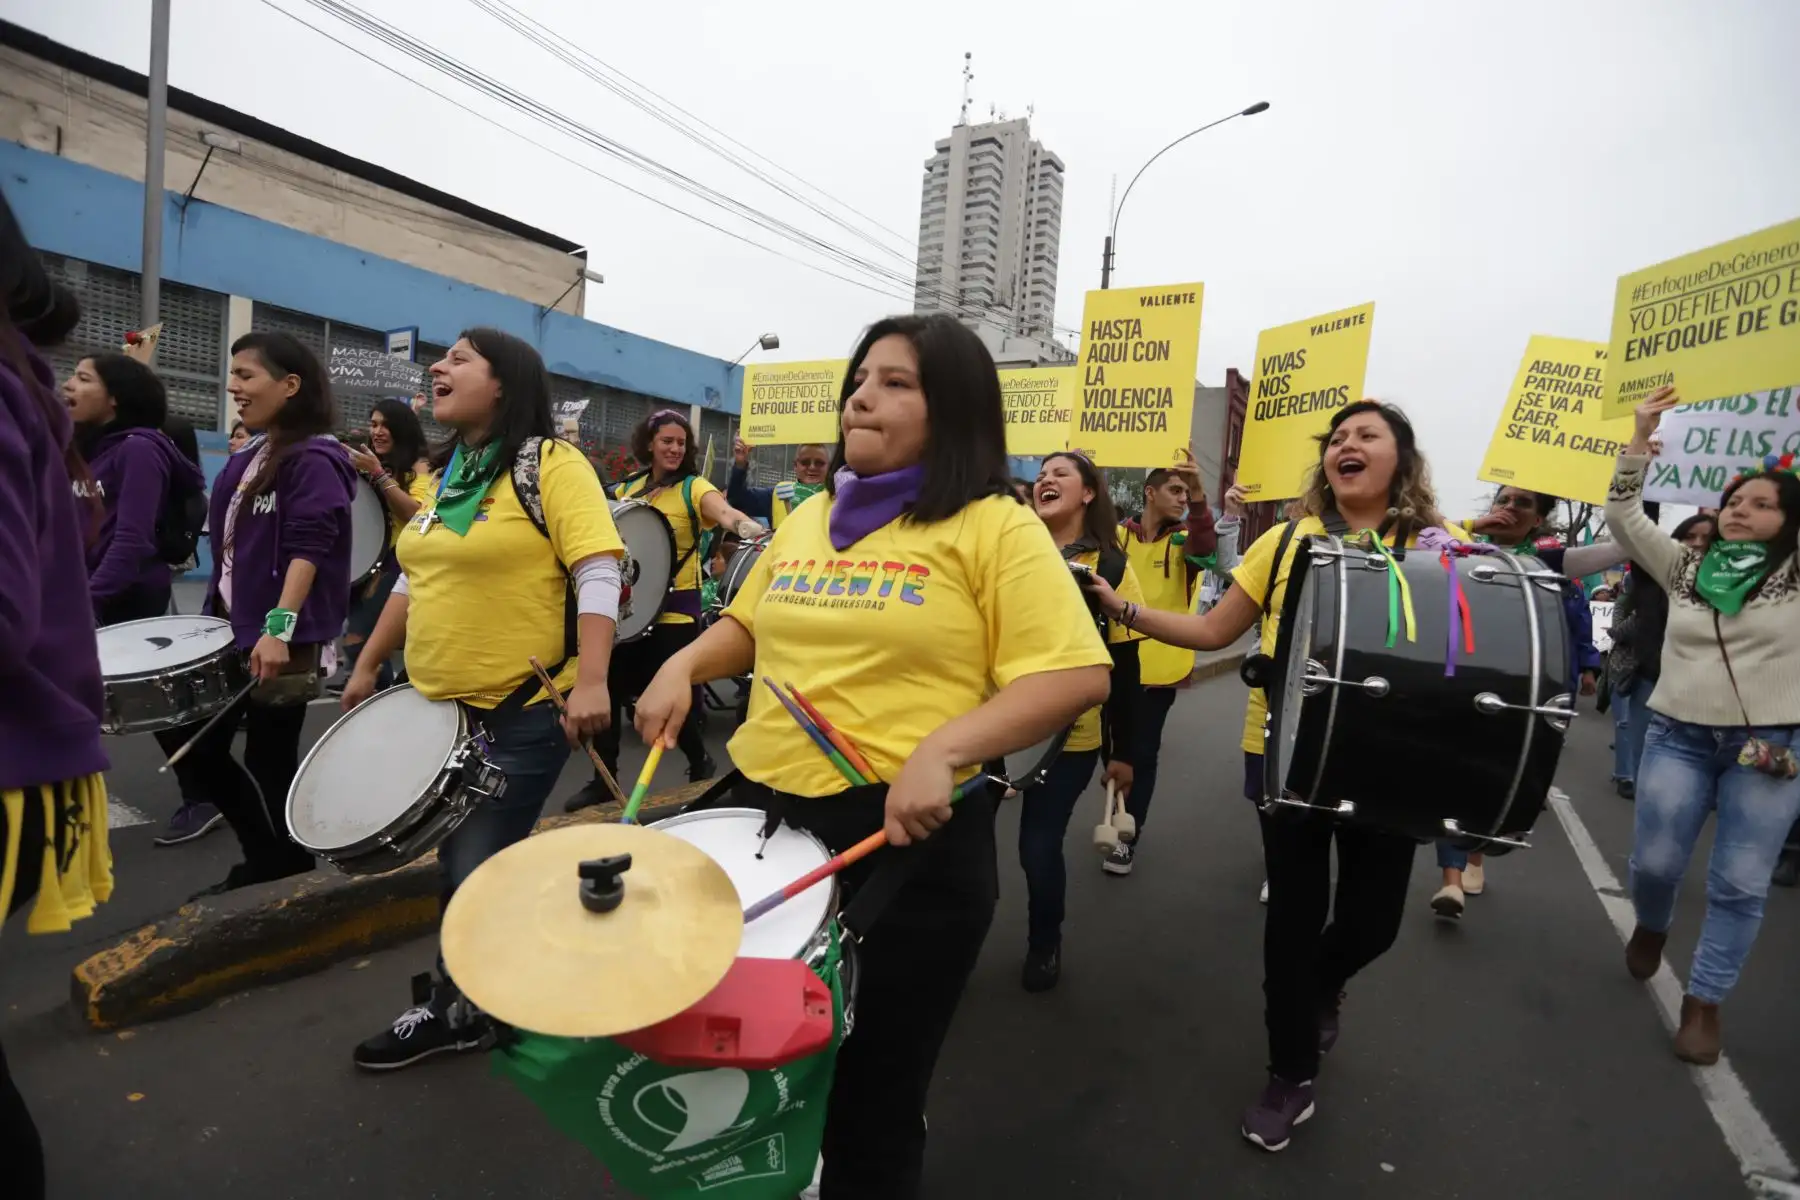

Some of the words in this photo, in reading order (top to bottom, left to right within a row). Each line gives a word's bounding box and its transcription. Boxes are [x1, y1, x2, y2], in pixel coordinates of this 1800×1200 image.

[1140, 292, 1196, 307] VALIENTE
[1630, 308, 1656, 334] YO
[1661, 273, 1781, 327] DEFIENDO
[1090, 318, 1142, 341] HASTA
[1310, 313, 1366, 336] VALIENTE
[1624, 315, 1730, 362] ENFOQUE
[1736, 305, 1772, 337] DE
[330, 356, 386, 368] PORQUE
[332, 347, 400, 364] MARCHO
[1132, 340, 1170, 362] CON
[1261, 348, 1306, 377] VIVAS
[374, 369, 408, 381] PERO
[1084, 365, 1105, 386] LA
[1528, 359, 1581, 380] ABAJO
[1583, 367, 1603, 382] EL
[1619, 369, 1674, 394] AMNISTÍA
[752, 386, 765, 400] YO
[768, 384, 818, 399] DEFIENDO
[820, 384, 832, 398] EL
[1083, 387, 1173, 409] VIOLENCIA
[1257, 374, 1291, 399] NOS
[1523, 375, 1604, 400] PATRIARC
[750, 400, 798, 415] ENFOQUE
[801, 400, 815, 414] DE
[1043, 393, 1056, 407] EL
[1254, 385, 1349, 421] QUEREMOS
[1550, 394, 1569, 412] VA
[1571, 399, 1584, 415] A
[1020, 409, 1036, 423] DE
[1039, 406, 1073, 423] GÉNE
[1080, 411, 1168, 433] MACHISTA
[1512, 407, 1560, 430] CAER,
[1505, 423, 1529, 440] SE
[1531, 427, 1551, 446] VA
[1553, 432, 1567, 448] A
[1683, 426, 1721, 455] DE
[1725, 428, 1776, 458] LAS
[1649, 461, 1682, 489] YA
[1688, 463, 1727, 492] NO
[765, 593, 816, 607] DEFENDEMOS
[819, 598, 828, 608] LA
[831, 599, 885, 611] DIVERSIDAD
[601, 1074, 621, 1098] para
